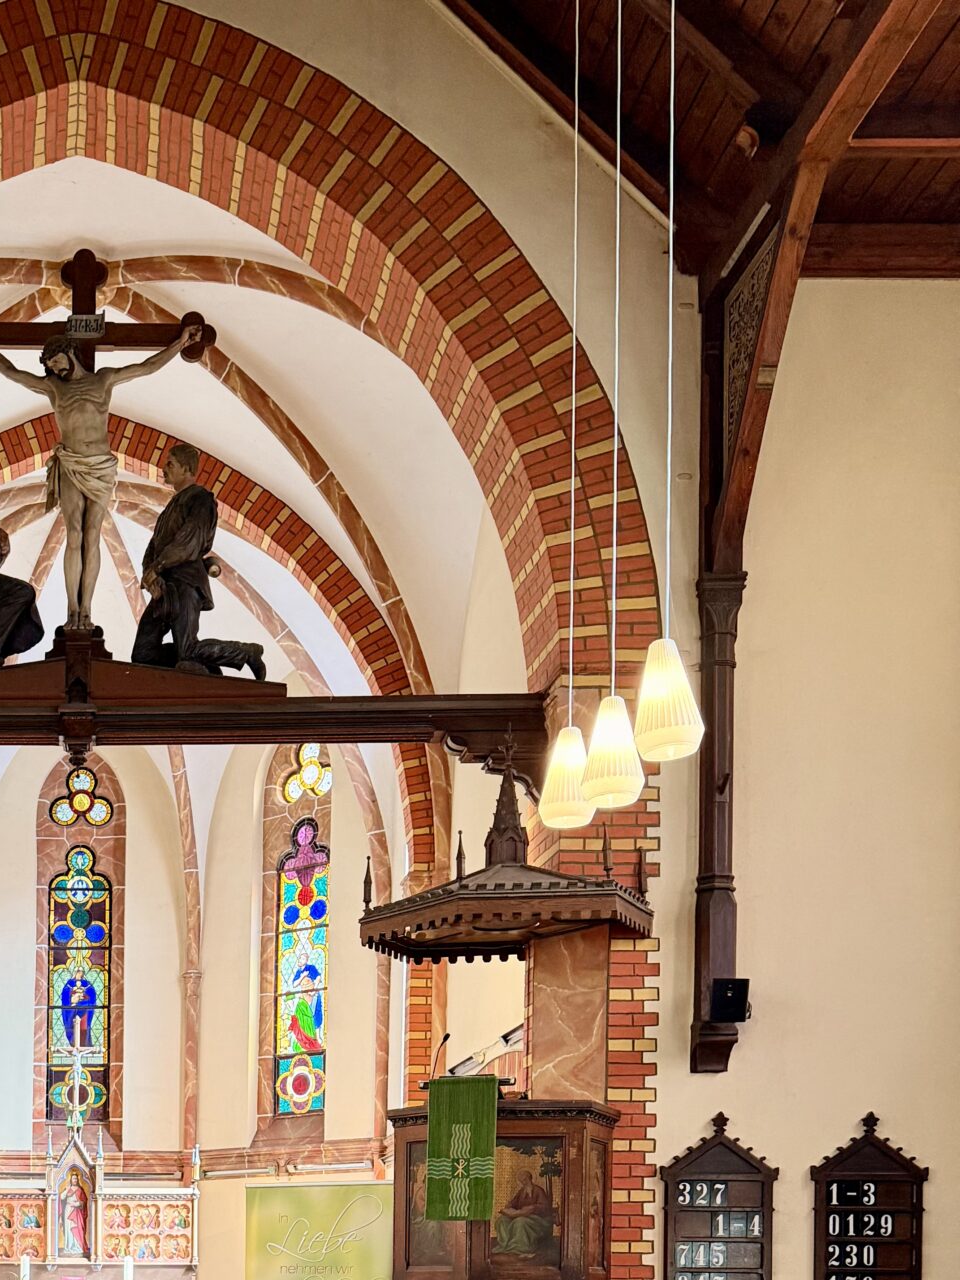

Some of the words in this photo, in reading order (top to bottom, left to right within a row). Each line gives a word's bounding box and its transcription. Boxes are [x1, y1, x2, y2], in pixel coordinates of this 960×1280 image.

[678, 1183, 725, 1205] 327
[266, 1195, 383, 1262] Liebe
[278, 1214, 288, 1224] In
[829, 1214, 892, 1236] 0129
[679, 1245, 724, 1265] 745
[829, 1245, 874, 1266] 230
[280, 1264, 332, 1274] nehmen
[336, 1265, 354, 1274] wir
